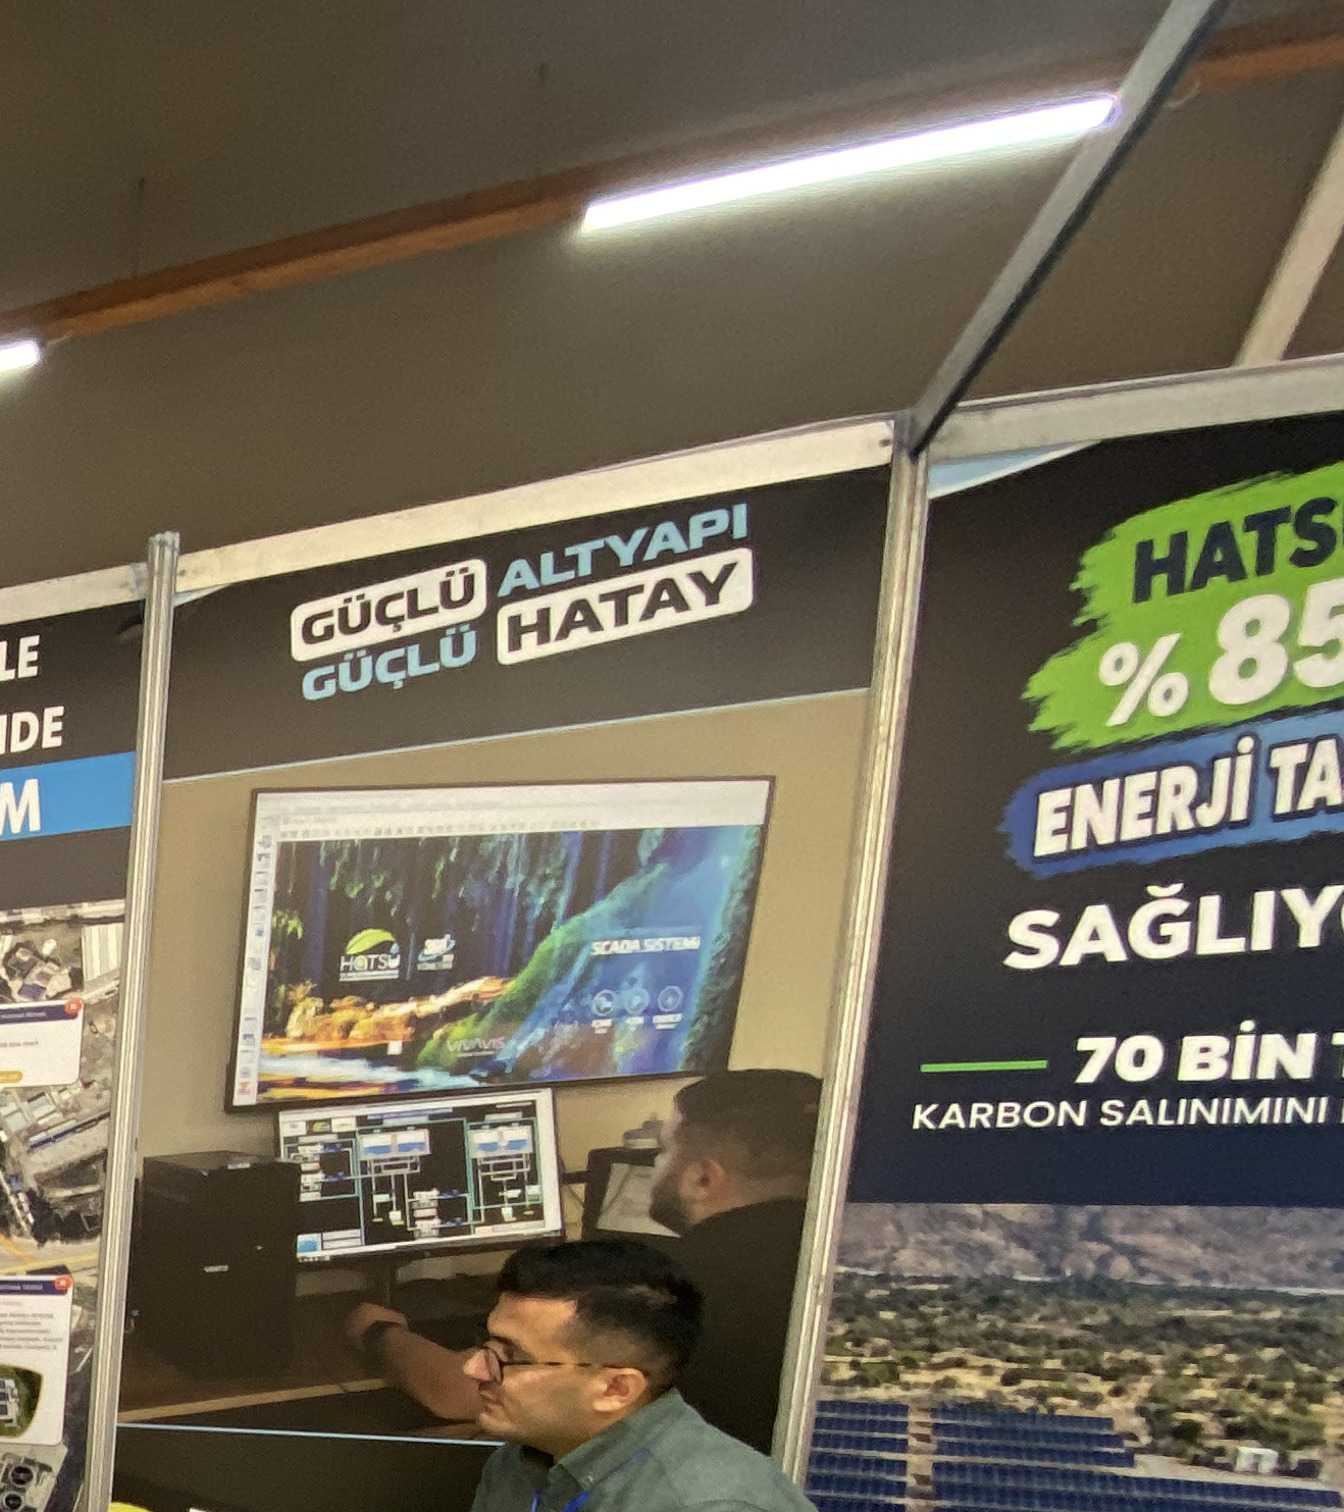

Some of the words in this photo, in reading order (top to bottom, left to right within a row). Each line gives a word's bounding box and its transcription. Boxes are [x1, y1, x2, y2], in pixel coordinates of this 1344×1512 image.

[301, 567, 476, 646] GÜÇLÜ
[497, 503, 749, 597] ALTYAPI
[1133, 497, 1344, 603] HATS
[302, 623, 478, 701] GÜÇLÜ
[507, 560, 738, 654] HATAY
[1098, 634, 1189, 727] %
[1208, 578, 1344, 707] 85
[1034, 737, 1256, 858] ENERJİ
[1003, 883, 1344, 970] SAĞLIY
[1075, 1034, 1165, 1084] 70
[1177, 1019, 1317, 1081] BİN
[913, 1100, 1088, 1130] KARBON
[1100, 1096, 1329, 1128] SALINIMINI
